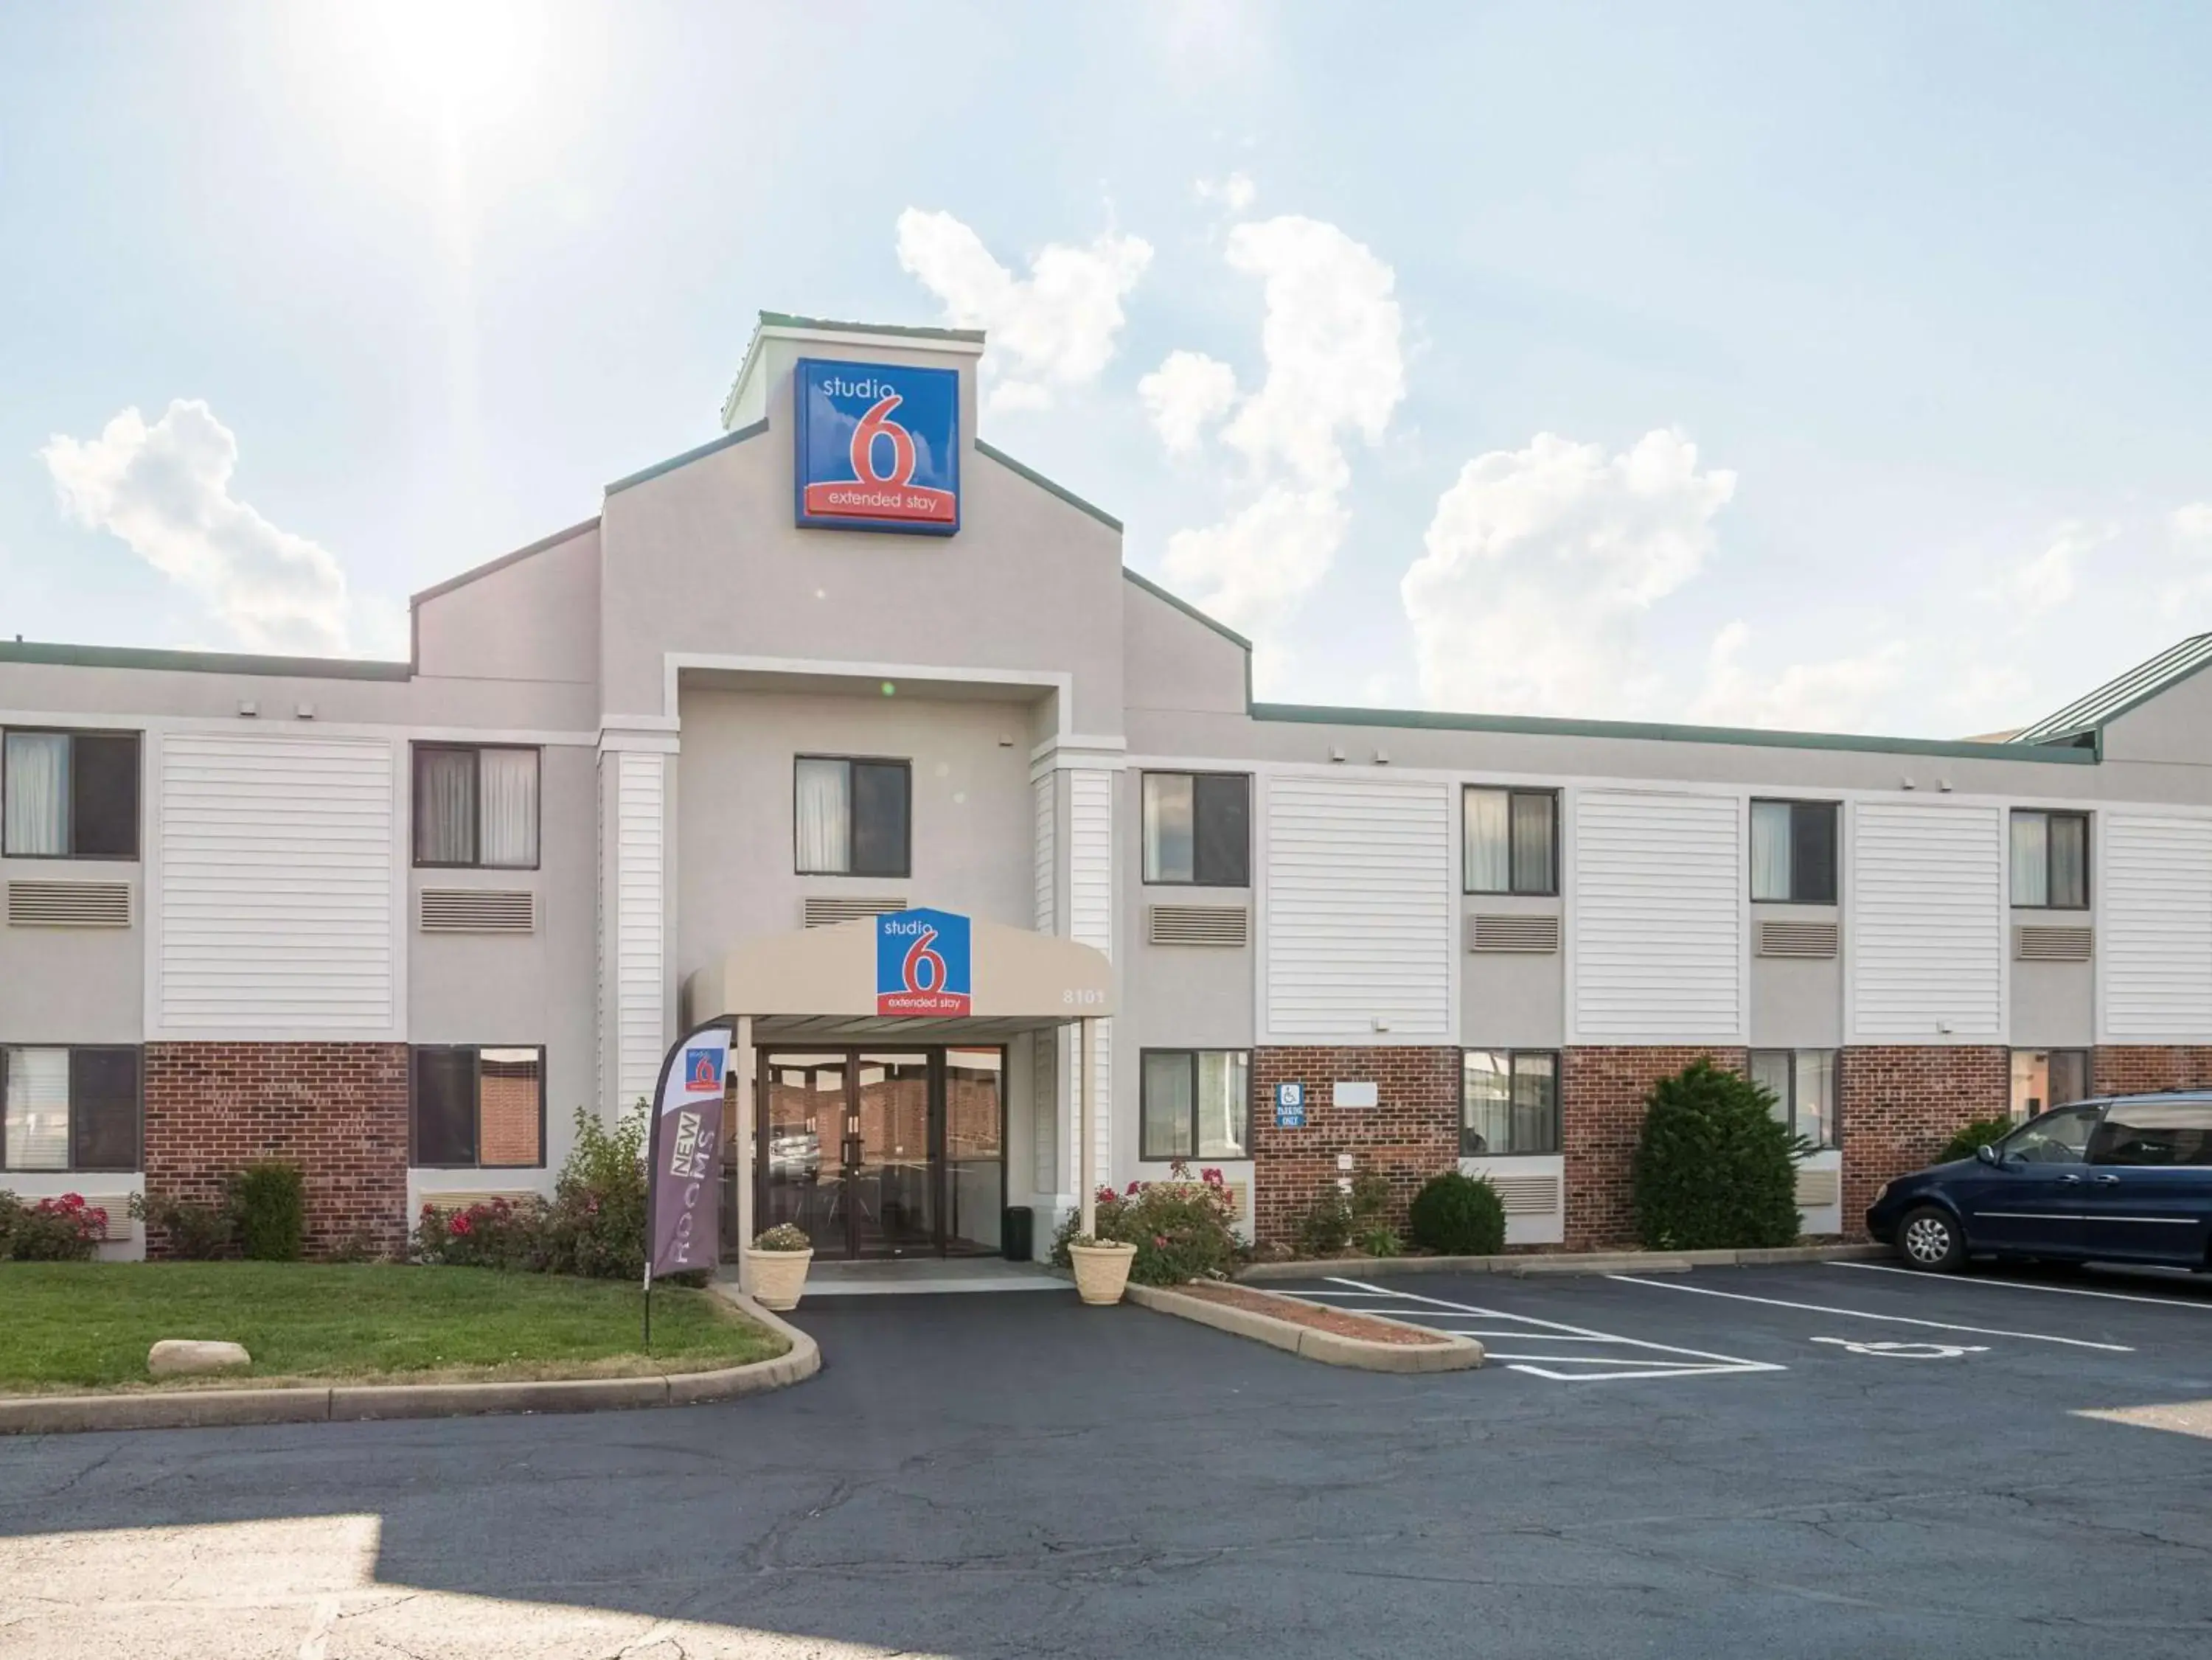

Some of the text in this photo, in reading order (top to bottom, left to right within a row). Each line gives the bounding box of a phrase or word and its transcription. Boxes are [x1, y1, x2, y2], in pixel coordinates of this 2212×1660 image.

[823, 377, 895, 399] studio
[850, 394, 917, 484] 6
[828, 491, 938, 512] extended stay
[885, 920, 933, 935] studio
[902, 930, 947, 992] 6
[888, 997, 961, 1009] extended stay
[1062, 988, 1105, 1004] 8101
[1281, 1116, 1298, 1126] ONLY
[673, 1114, 698, 1175] NEW
[672, 1130, 714, 1263] ROOMS
